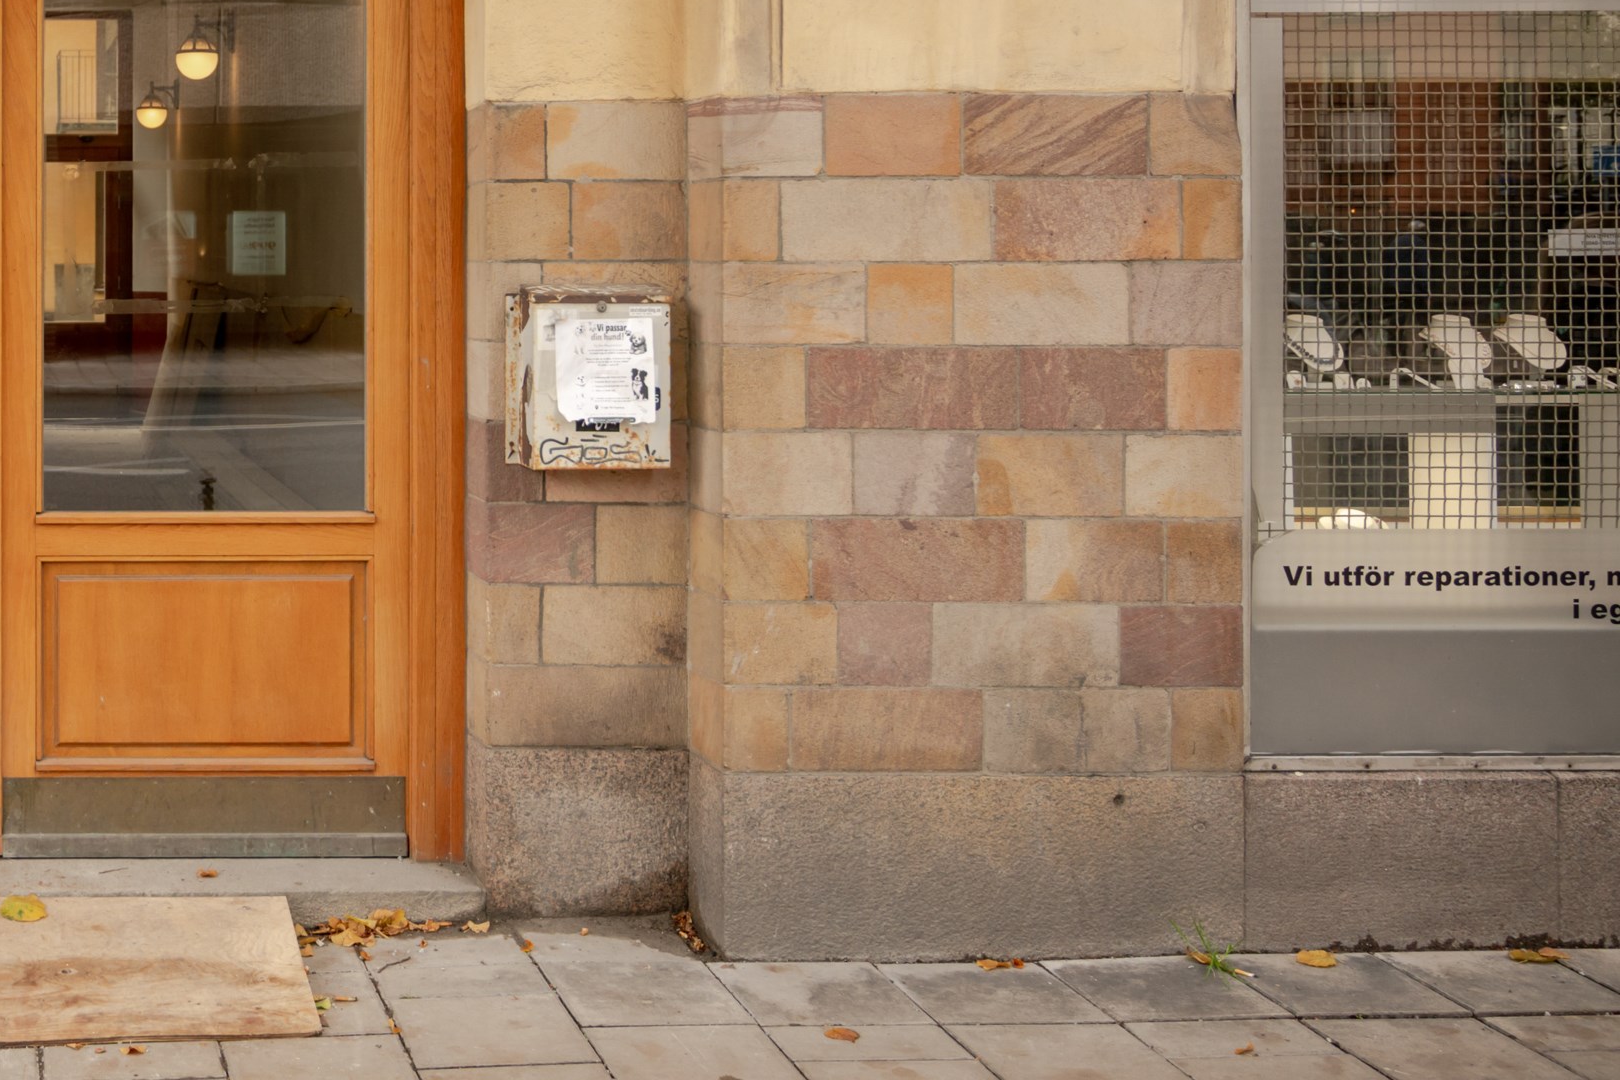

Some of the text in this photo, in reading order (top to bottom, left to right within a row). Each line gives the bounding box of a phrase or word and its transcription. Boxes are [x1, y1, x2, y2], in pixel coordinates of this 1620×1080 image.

[597, 323, 627, 334] Vi passar
[591, 333, 624, 341] din hund!
[1283, 565, 1312, 586] Vi
[1323, 565, 1395, 587] utför
[1404, 565, 1596, 592] reparationer,
[1572, 598, 1580, 619] i
